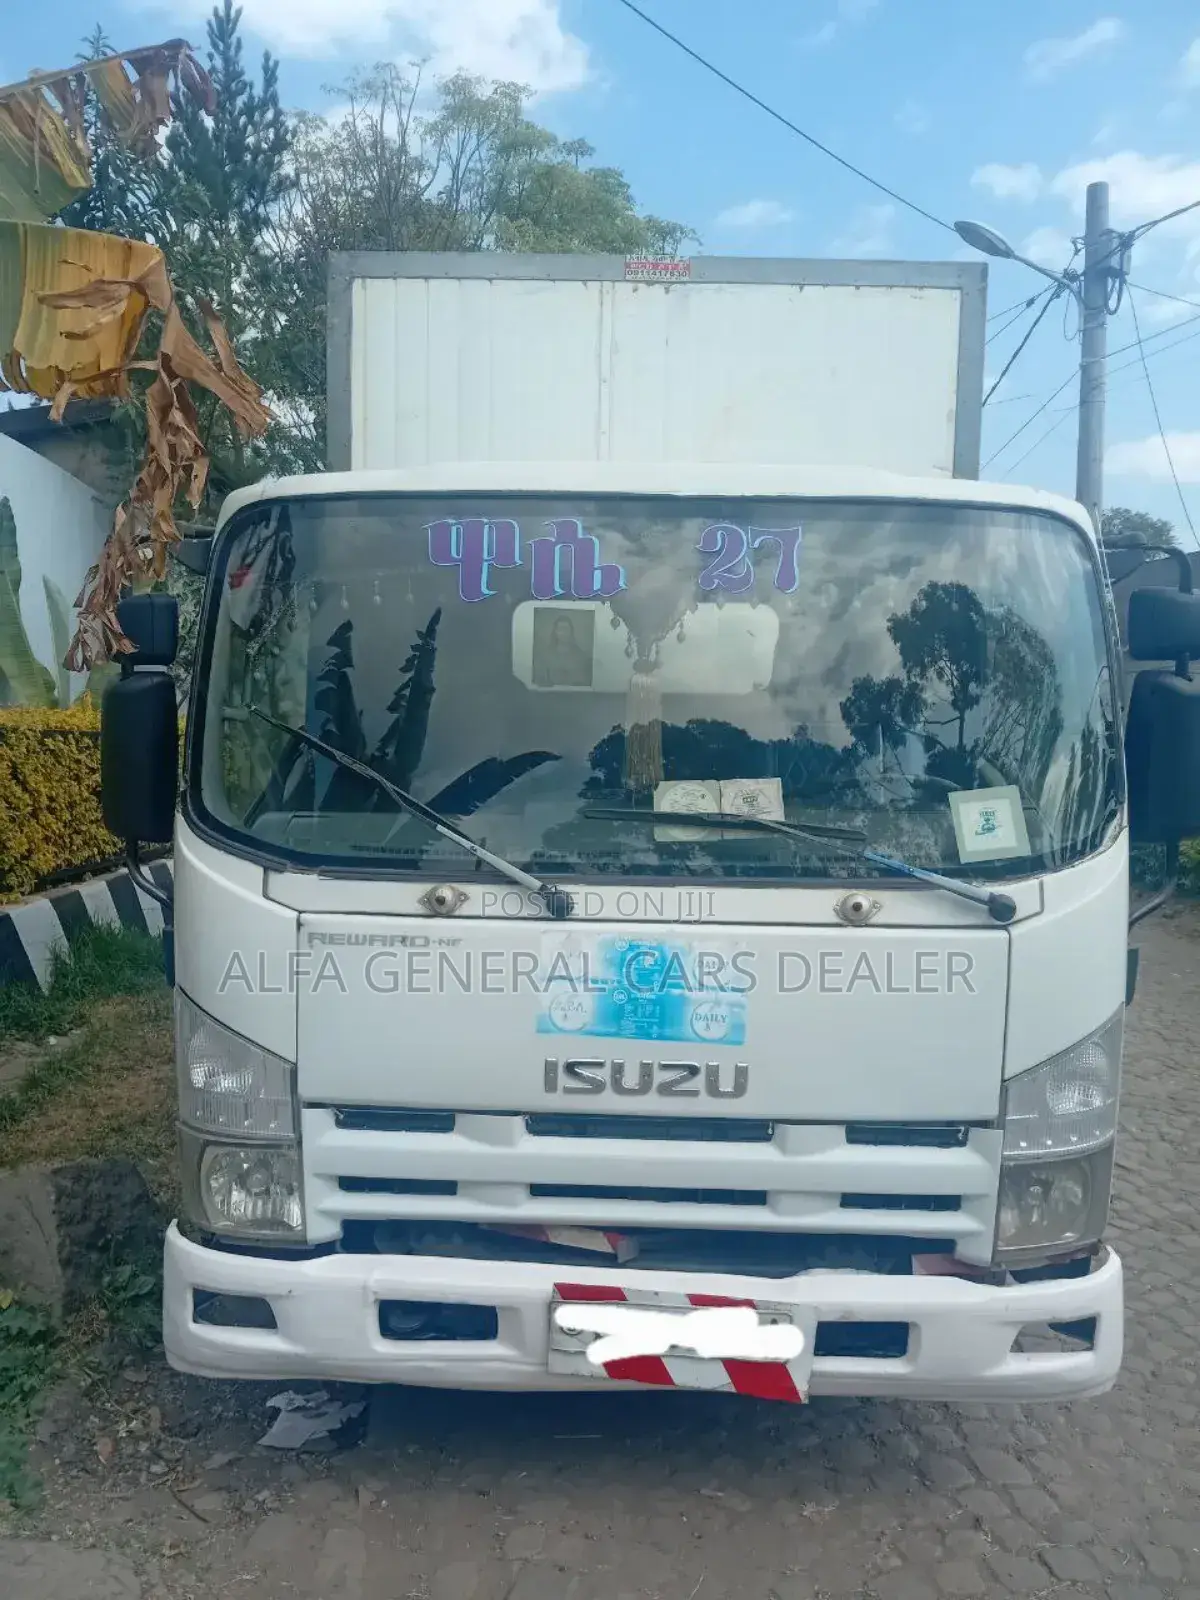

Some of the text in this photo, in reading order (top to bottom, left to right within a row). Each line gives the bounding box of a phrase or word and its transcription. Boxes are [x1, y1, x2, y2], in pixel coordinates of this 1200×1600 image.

[696, 524, 802, 594] 27
[694, 1012, 728, 1024] DAILY
[544, 1058, 749, 1099] ISUZU
